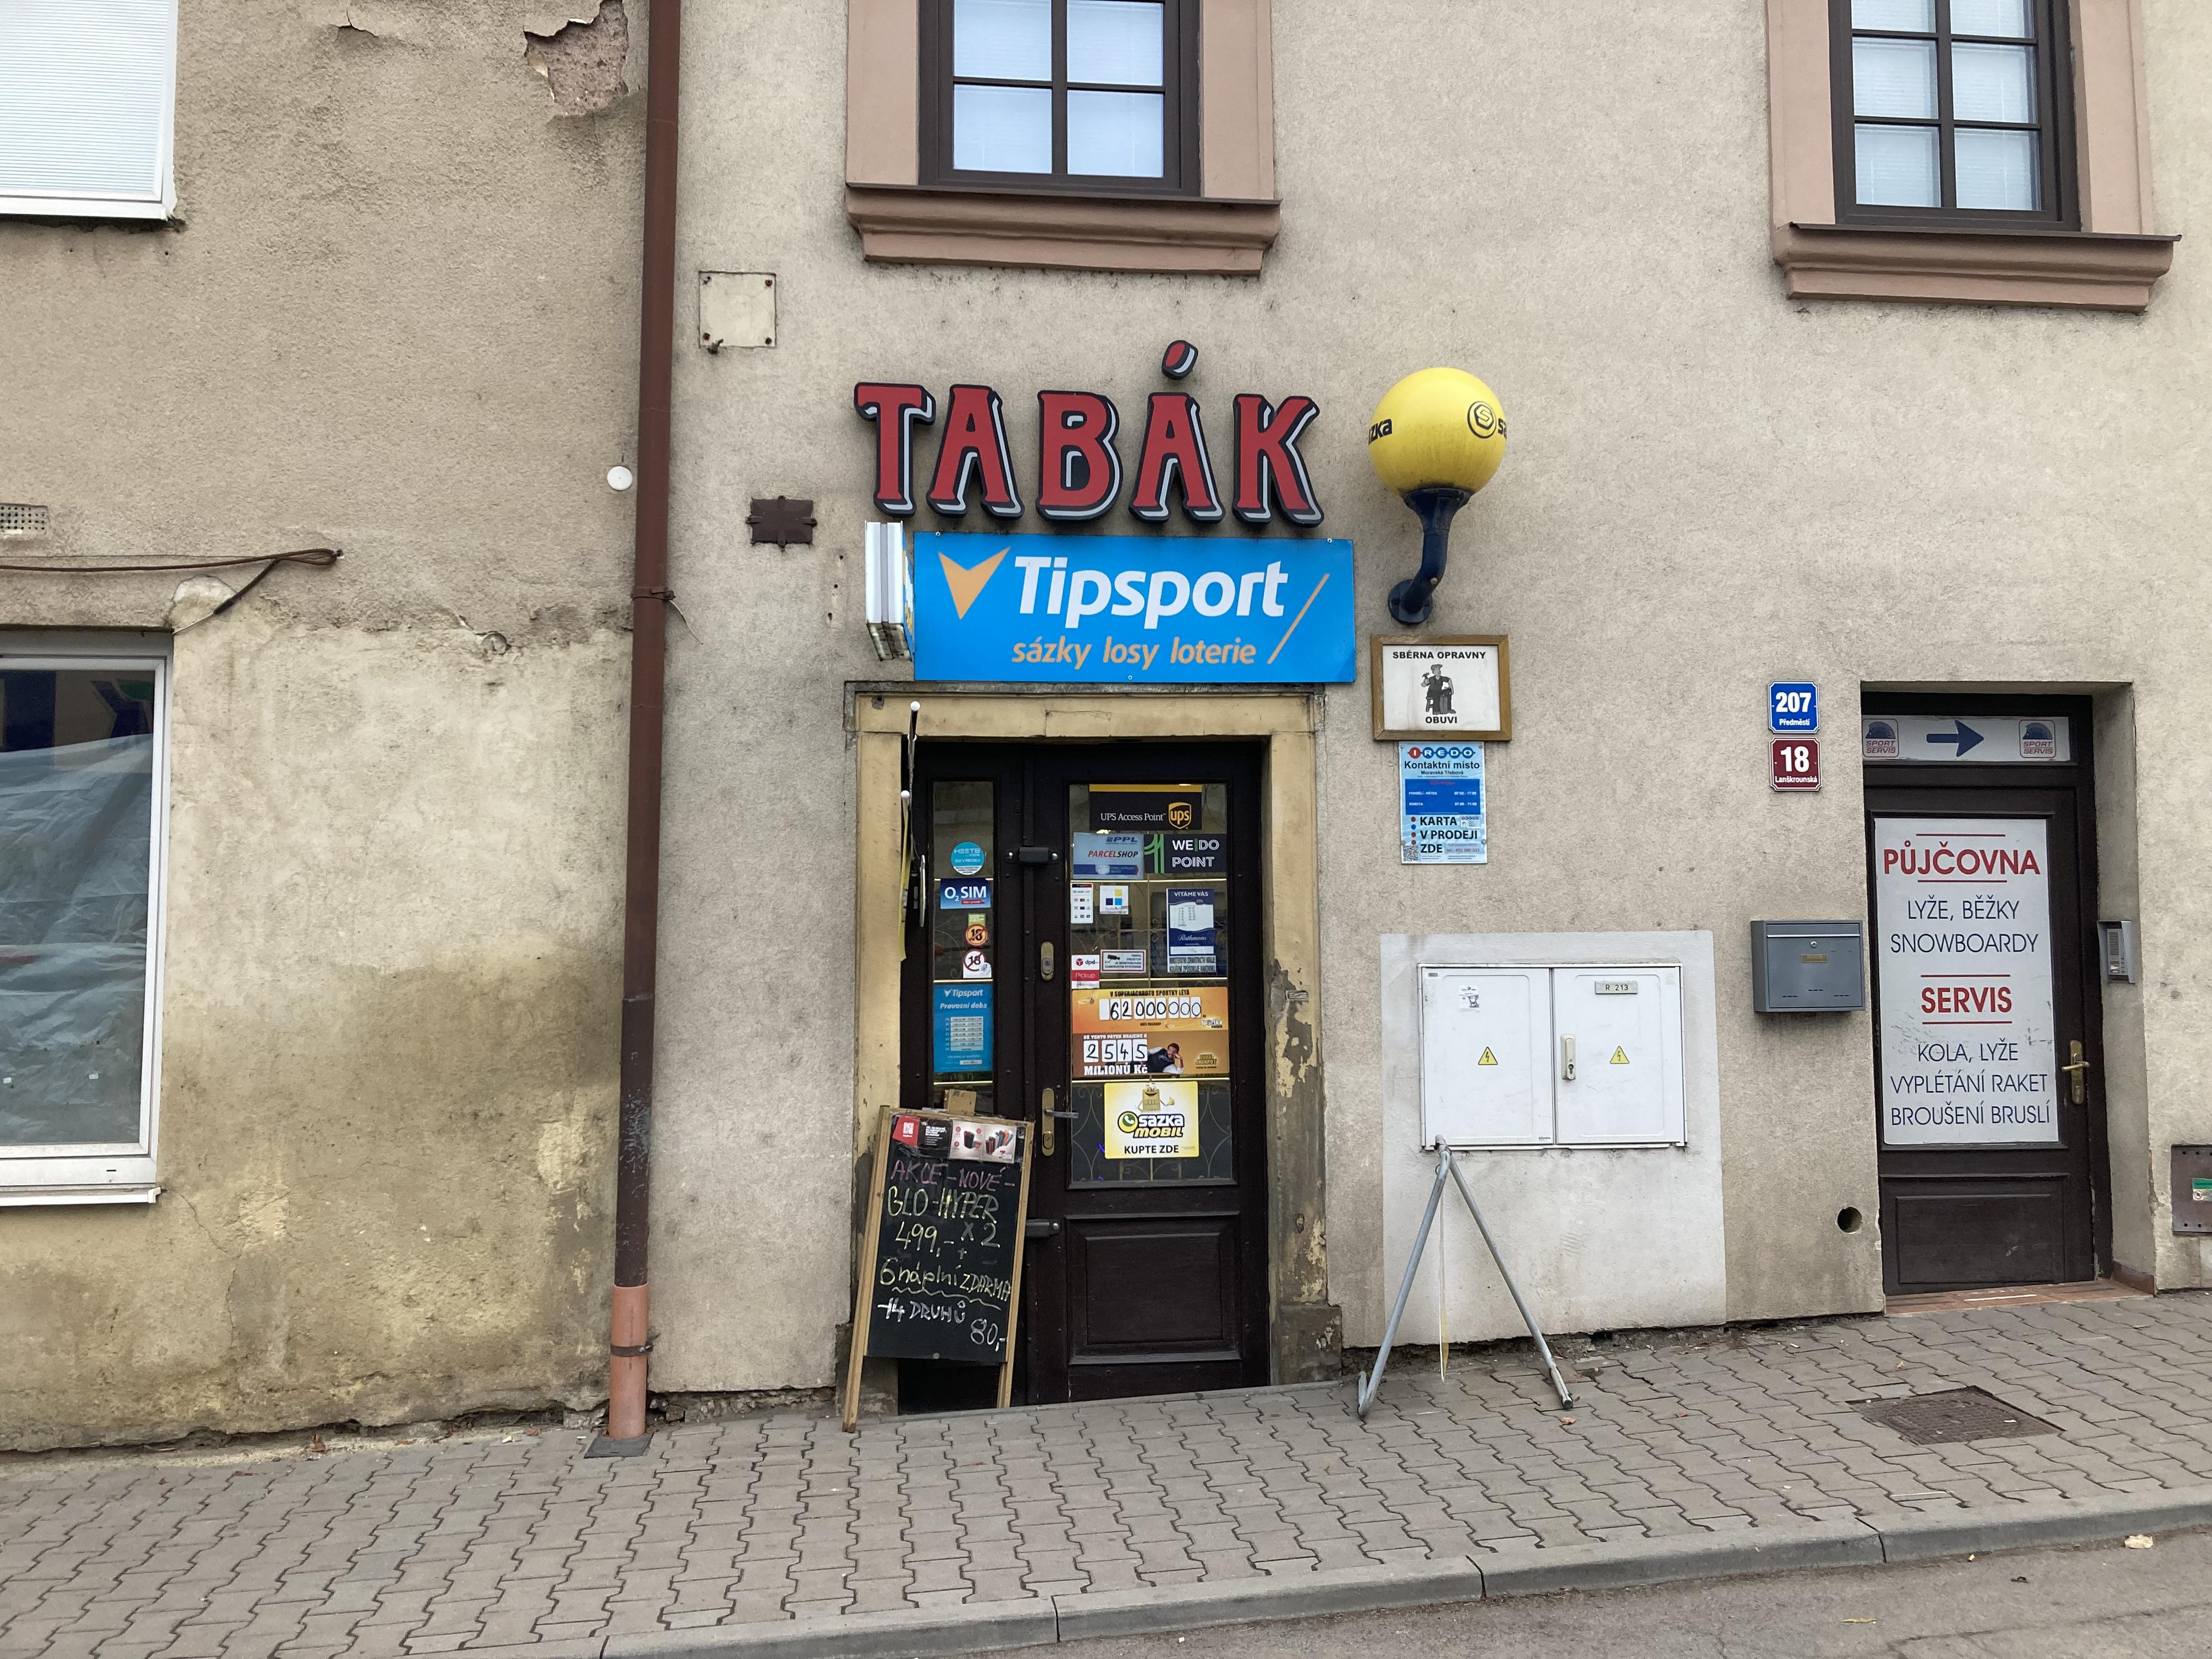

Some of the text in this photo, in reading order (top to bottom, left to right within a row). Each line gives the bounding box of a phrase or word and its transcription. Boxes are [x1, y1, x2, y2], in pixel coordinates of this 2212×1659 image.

[854, 340, 1325, 528] TABÁK
[1014, 556, 1288, 629] Tipsport
[1011, 635, 1258, 670] sázky losy loterie
[1392, 650, 1434, 659] SBĚRNA
[1776, 692, 1811, 712] 207
[1410, 749, 1473, 757] IREDO
[1781, 746, 1809, 772] 18
[1404, 760, 1450, 769] Kontaktní
[1420, 817, 1457, 826] KARTA
[1420, 831, 1478, 839] V PRODEJI
[1421, 844, 1442, 853] ZDE
[1172, 857, 1215, 868] POINT
[1884, 841, 2041, 875] PŮJČOVNA
[961, 886, 987, 899] SIM
[1908, 894, 2020, 921] LYŽE, BĚŽKY
[971, 929, 983, 941] 18
[1891, 933, 2038, 953] SNOWBOARDY
[968, 956, 980, 965] 18
[952, 989, 983, 998] Tipsport
[1921, 987, 2012, 1013] SERVIS
[1918, 1037, 2018, 1063] KOLA, LYŽE
[1084, 1062, 1147, 1075] MILIONŮ Kč
[1890, 1069, 2048, 1094] VYPLÉTÁNÍ RAKET
[1891, 1099, 2051, 1125] BROUŠENÍ BRUSLÍ
[1124, 1146, 1156, 1154] KUPTE
